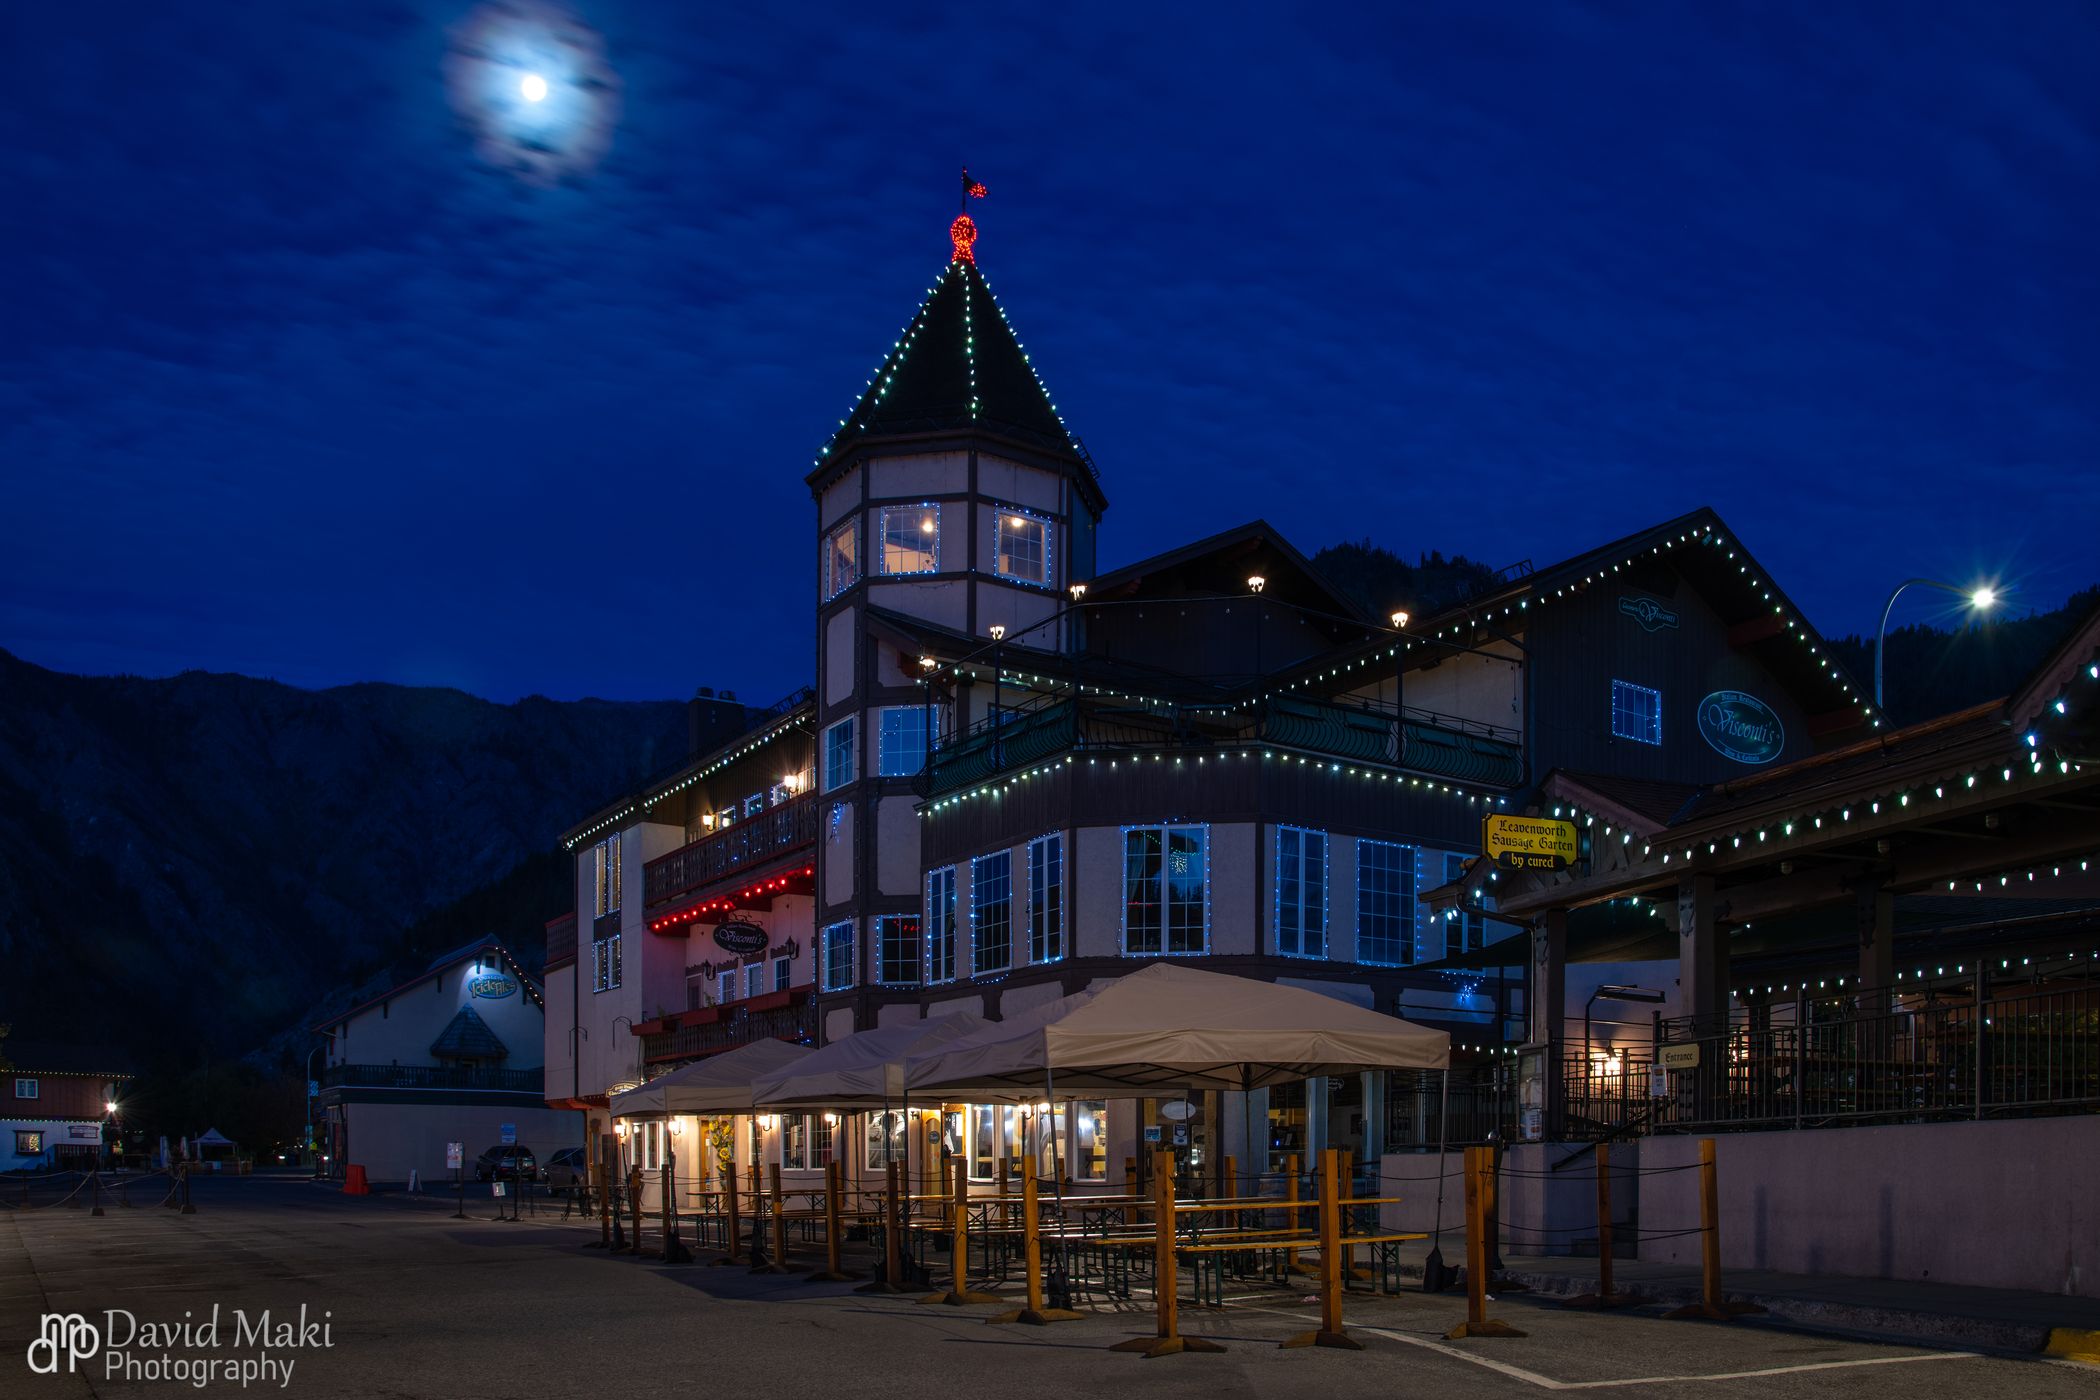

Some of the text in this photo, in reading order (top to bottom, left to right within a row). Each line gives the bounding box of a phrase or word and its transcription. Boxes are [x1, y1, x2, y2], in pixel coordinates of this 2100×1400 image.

[1708, 703, 1774, 745] Visconti's
[1499, 820, 1566, 837] Leavenworth
[1492, 832, 1573, 851] Sausage Garten
[1511, 853, 1554, 869] by cured
[720, 929, 762, 944] Visconti's
[1665, 1052, 1693, 1063] Entrance
